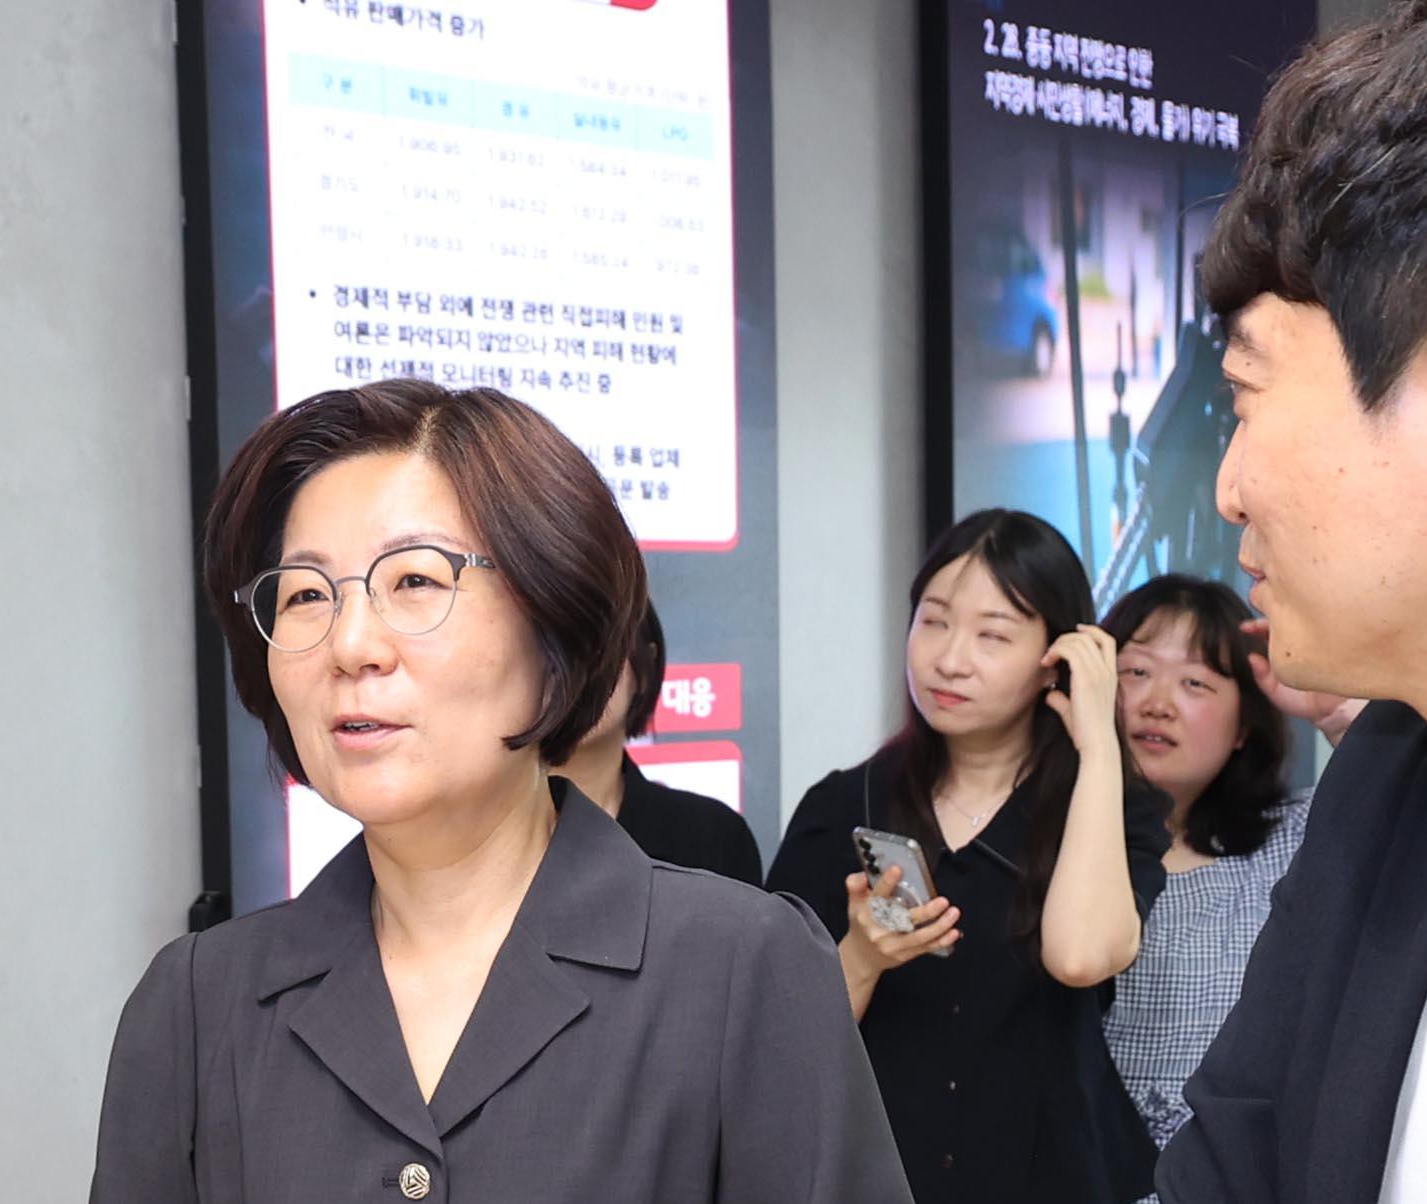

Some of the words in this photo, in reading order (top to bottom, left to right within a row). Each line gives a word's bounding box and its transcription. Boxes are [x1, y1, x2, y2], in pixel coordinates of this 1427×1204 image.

[368, 0, 443, 33] 판매가격
[450, 14, 486, 41] 증가
[983, 18, 999, 56] 2.
[1025, 25, 1053, 71] 중동
[1053, 31, 1080, 75] 지역
[334, 284, 389, 311] 경제적
[397, 290, 432, 315] 부담
[440, 294, 474, 318] 외에
[481, 297, 514, 321] 전쟁
[523, 301, 554, 325] 관련
[562, 304, 626, 331] 직접피해
[334, 320, 390, 345] 여론은
[398, 325, 471, 351] 파악되지
[477, 330, 547, 356] 않았으나
[555, 336, 586, 360] 지역
[593, 341, 623, 363] 피해
[335, 356, 372, 380] 대한
[442, 363, 513, 389] 모니터링
[521, 368, 552, 391] 지속
[560, 371, 591, 394] 추진
[598, 373, 612, 395] 중
[661, 676, 717, 718] 대응
